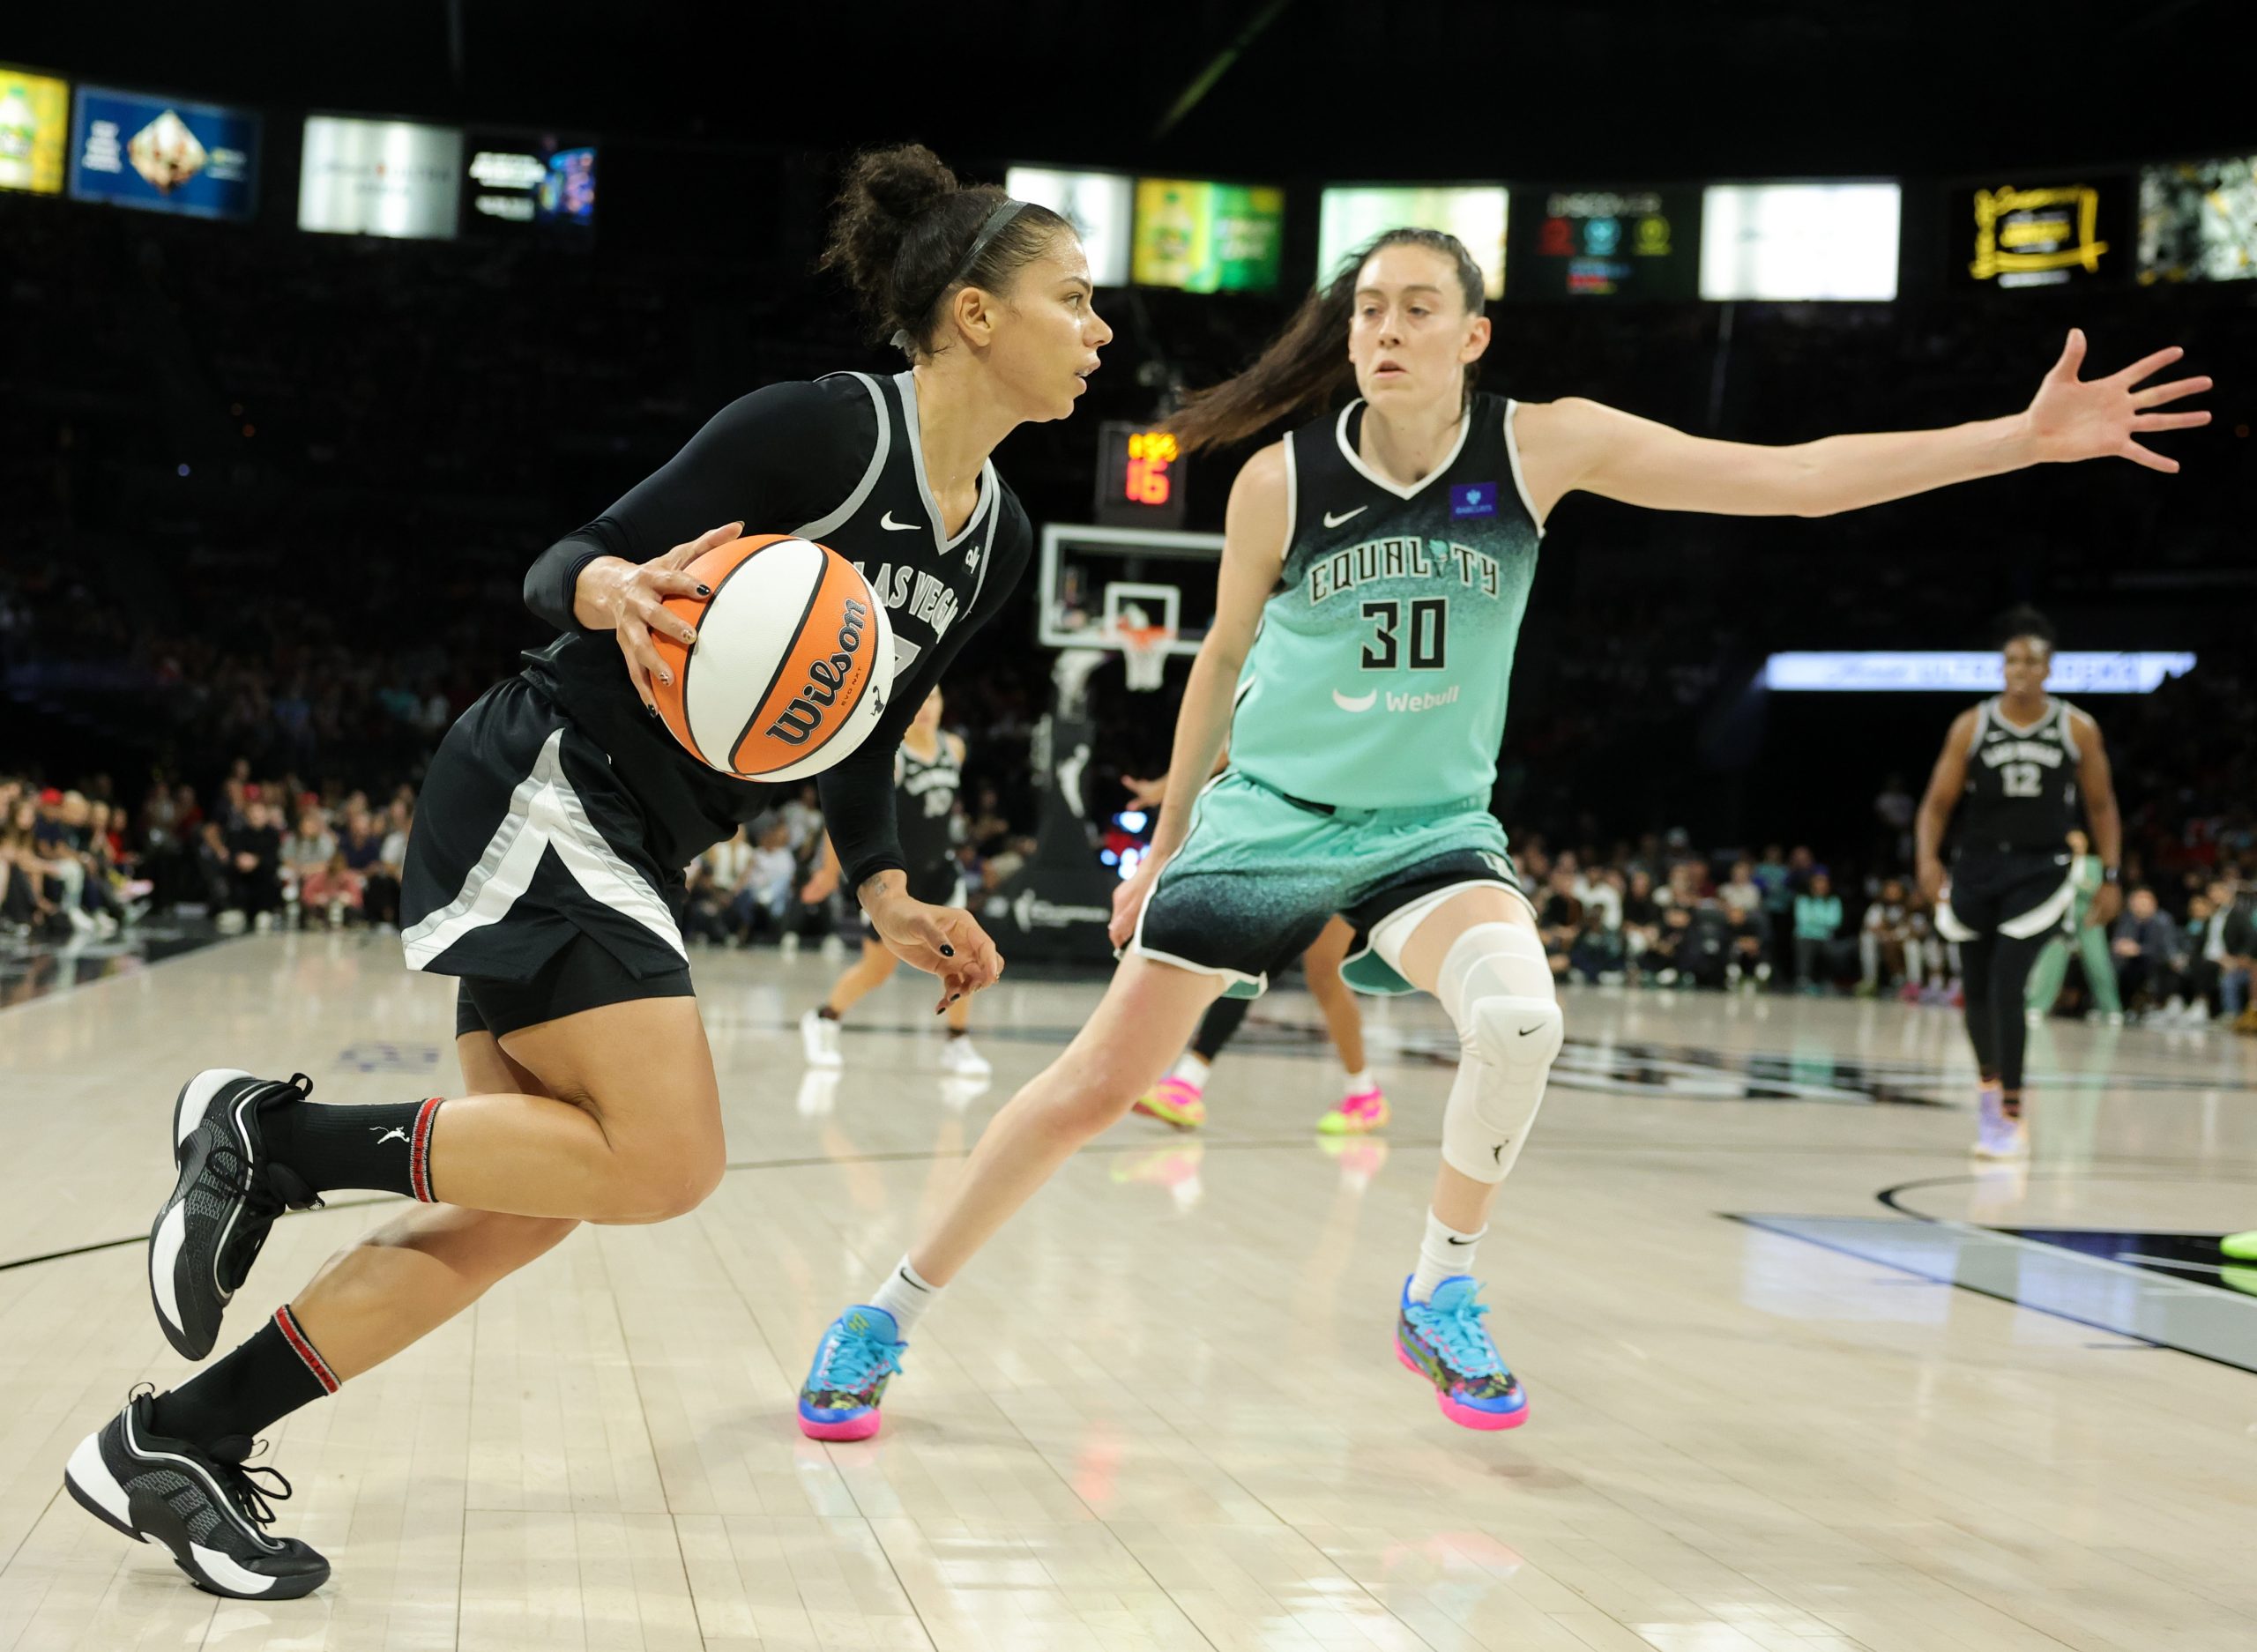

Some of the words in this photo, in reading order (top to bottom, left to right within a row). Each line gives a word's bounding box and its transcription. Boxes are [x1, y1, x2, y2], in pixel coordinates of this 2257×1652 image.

[1359, 595, 1449, 672] 30
[764, 599, 867, 746] Wilson
[852, 666, 861, 685] NXT
[1386, 685, 1461, 712] Webull
[2000, 762, 2043, 797] 12
